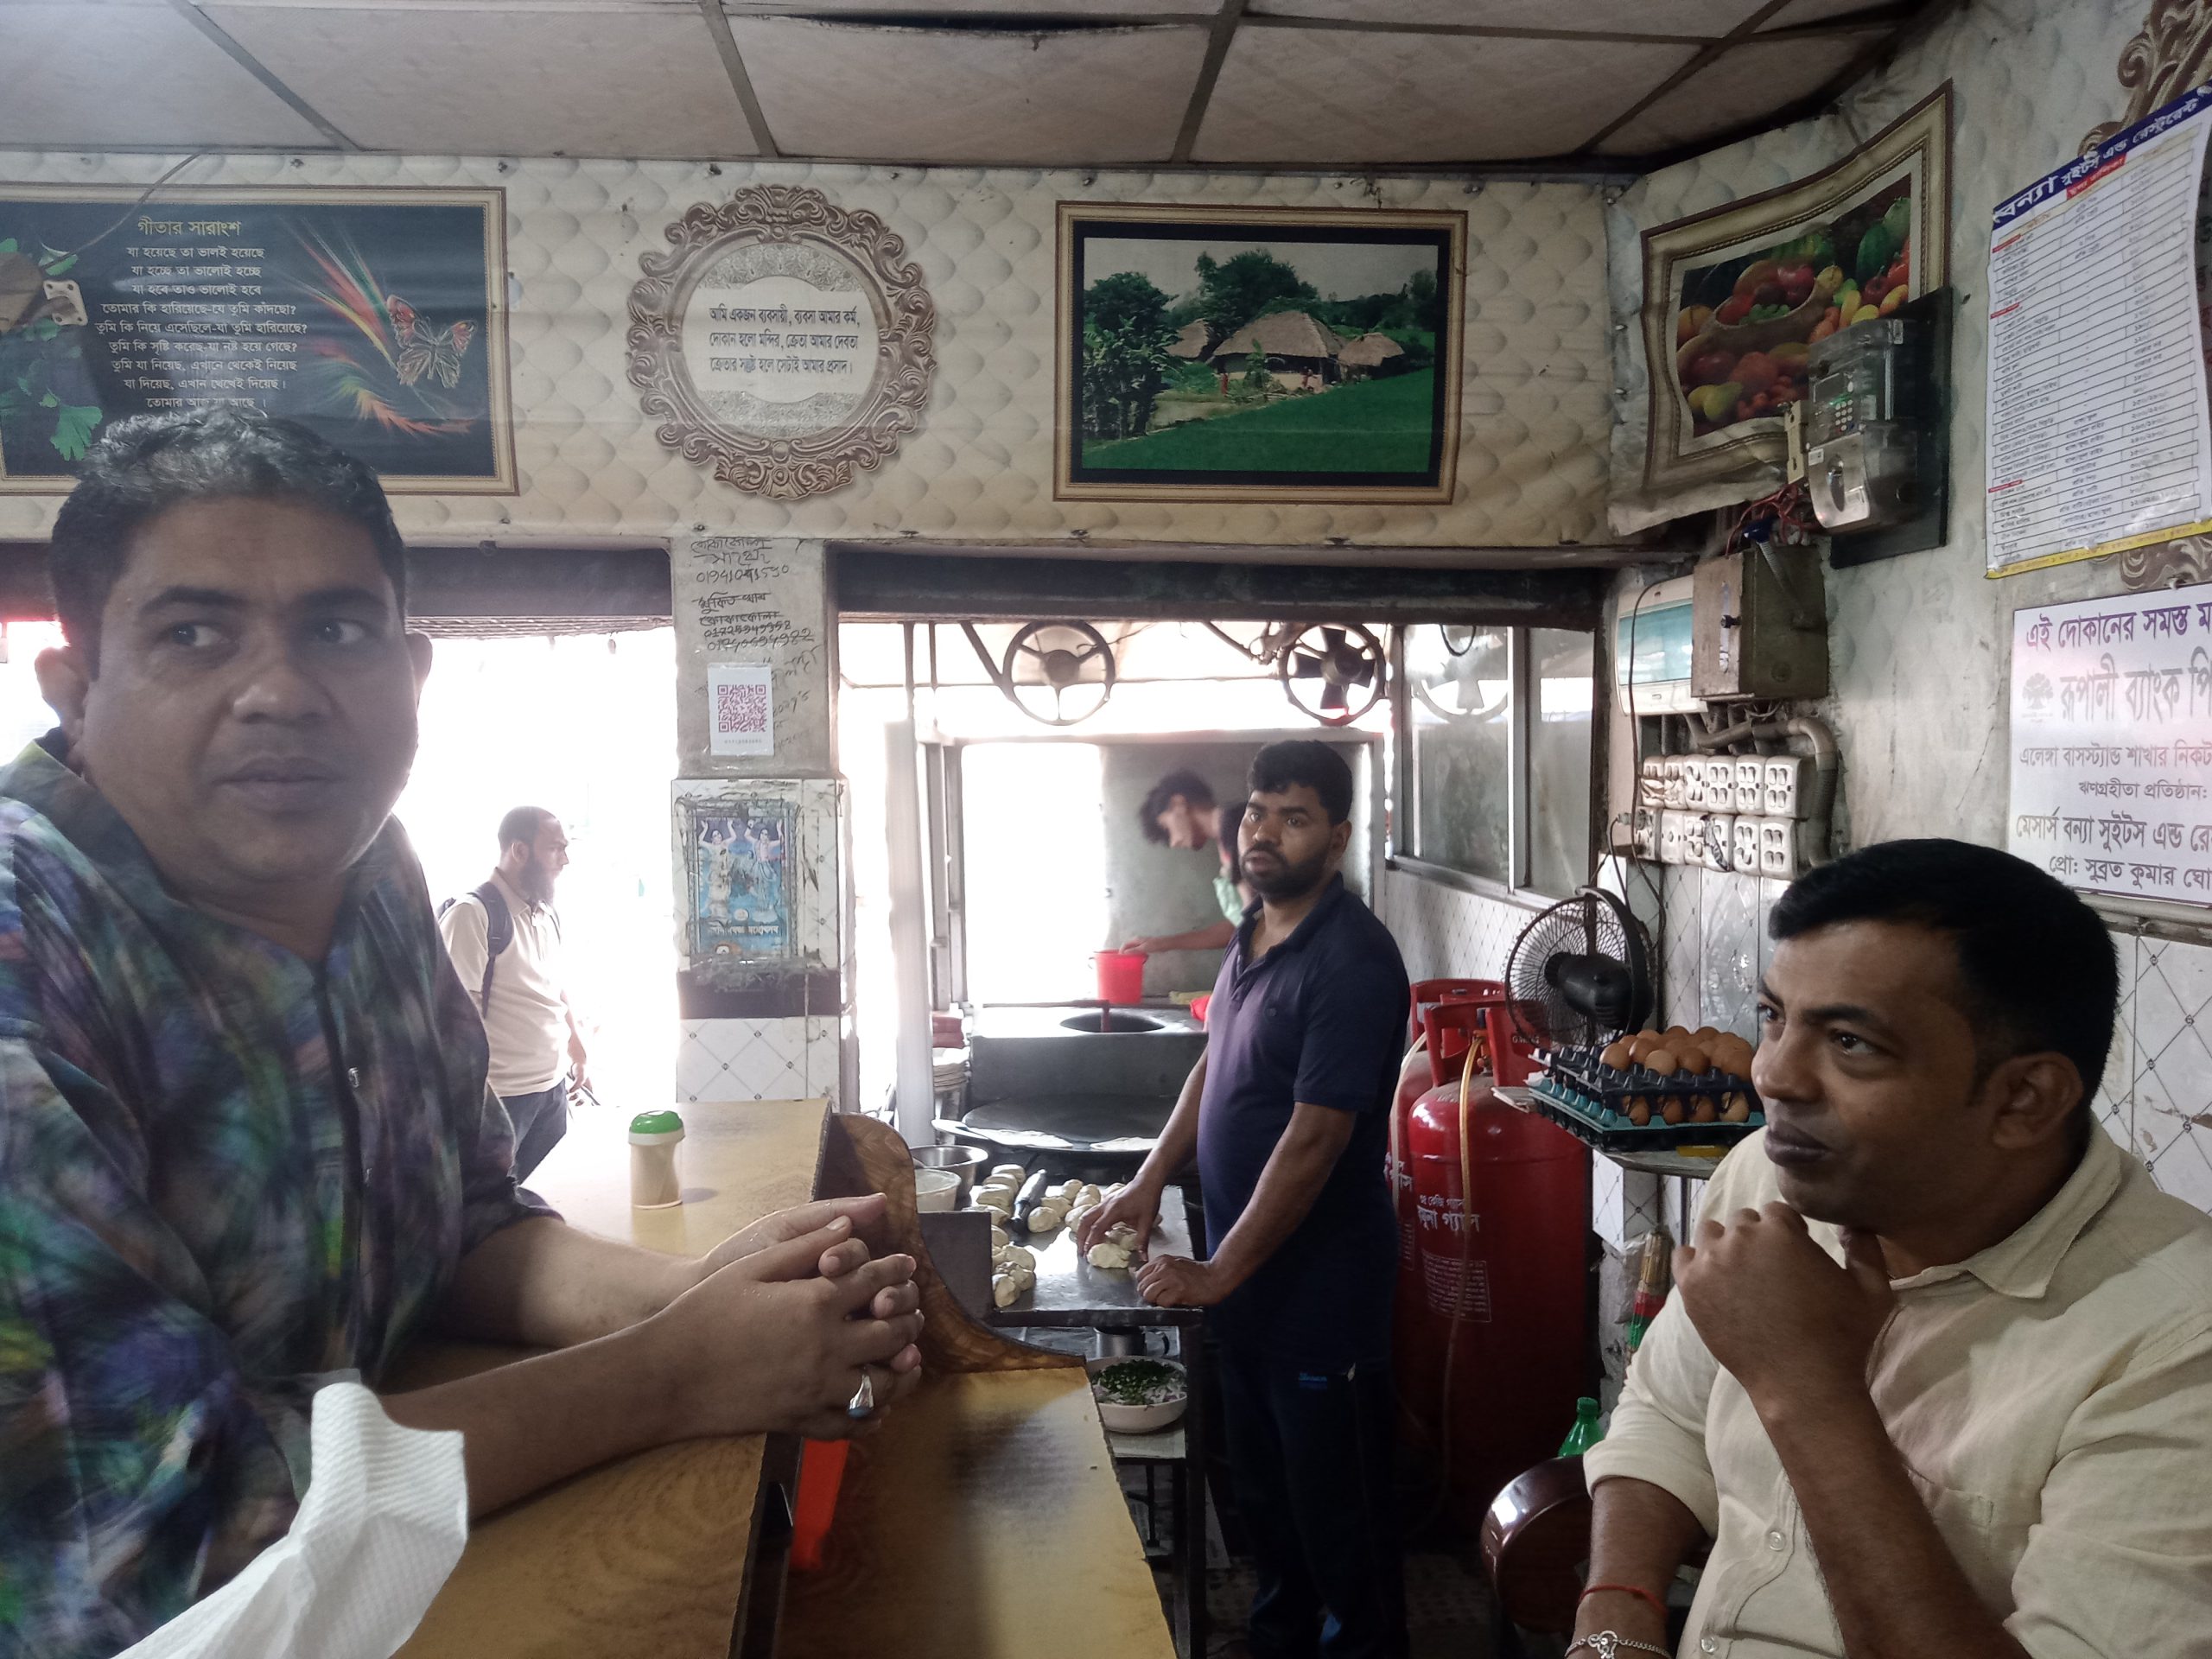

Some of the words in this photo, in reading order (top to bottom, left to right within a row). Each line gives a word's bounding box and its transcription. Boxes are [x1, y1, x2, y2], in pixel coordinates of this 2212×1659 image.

[1993, 175, 2059, 223] বন্যা
[137, 215, 183, 237] গীতার
[188, 220, 242, 237] সারাংশ
[126, 246, 139, 258] যা
[143, 247, 177, 259] হয়েছে
[181, 247, 194, 258] তা
[197, 245, 228, 259] ভালই
[232, 247, 265, 260] হয়েছে
[131, 265, 143, 276] যা
[147, 265, 173, 277] হচ্ছে
[175, 265, 190, 276] তা
[194, 264, 232, 277] ভালোই
[235, 266, 262, 277] হচ্ছে
[131, 284, 143, 295] যা
[199, 283, 238, 296] ভালোই
[240, 284, 262, 296] হবে
[101, 303, 139, 315] তোমার
[142, 301, 156, 315] কি
[227, 301, 250, 317] তুমি
[253, 301, 296, 315] কাঁদছো?
[709, 303, 728, 321] আমি
[730, 308, 756, 322] একজন
[794, 309, 816, 324] ব্যবসা
[818, 310, 841, 324] আমার
[94, 321, 117, 335] তুমি
[120, 321, 134, 333] কি
[137, 321, 161, 334] নিয়ে
[231, 321, 252, 335] তুমি
[108, 340, 130, 354] তুমি
[132, 340, 147, 353] কি
[149, 339, 170, 356] সৃষ্টি
[222, 340, 238, 353] নষ্ট
[242, 342, 262, 353] হয়ে
[265, 341, 298, 353] গেছে?
[709, 332, 736, 346] দোকান
[738, 333, 756, 348] হলো
[786, 334, 808, 348] ক্রেতা
[810, 334, 832, 349] আমার
[834, 335, 859, 350] দেবতা
[111, 358, 132, 373] তুমি
[136, 359, 148, 371] যা
[190, 359, 224, 372] এখানে
[227, 359, 263, 372] থেকেই
[265, 358, 298, 372] নিয়েছ
[802, 359, 824, 374] আমার
[123, 378, 136, 390] যা
[178, 379, 207, 390] এখান
[146, 397, 183, 408] তোমার
[227, 397, 256, 408] আছে
[2026, 613, 2053, 652] এই
[2058, 611, 2138, 649] দোকানের
[2141, 604, 2191, 639] সমস্ত
[2123, 663, 2183, 724] ব্যাংক
[2020, 747, 2059, 767] এলেঙ্গা
[2063, 741, 2123, 768] বাসস্ট্যান্ড
[2126, 746, 2169, 768] শাখার
[2016, 805, 2060, 842] মেসার্স
[2063, 815, 2094, 844] বন্যা
[2098, 809, 2147, 853] সুইটস
[2152, 822, 2184, 849] এন্ড
[2084, 858, 2125, 885] সুব্রত
[2127, 862, 2177, 890] কুমার
